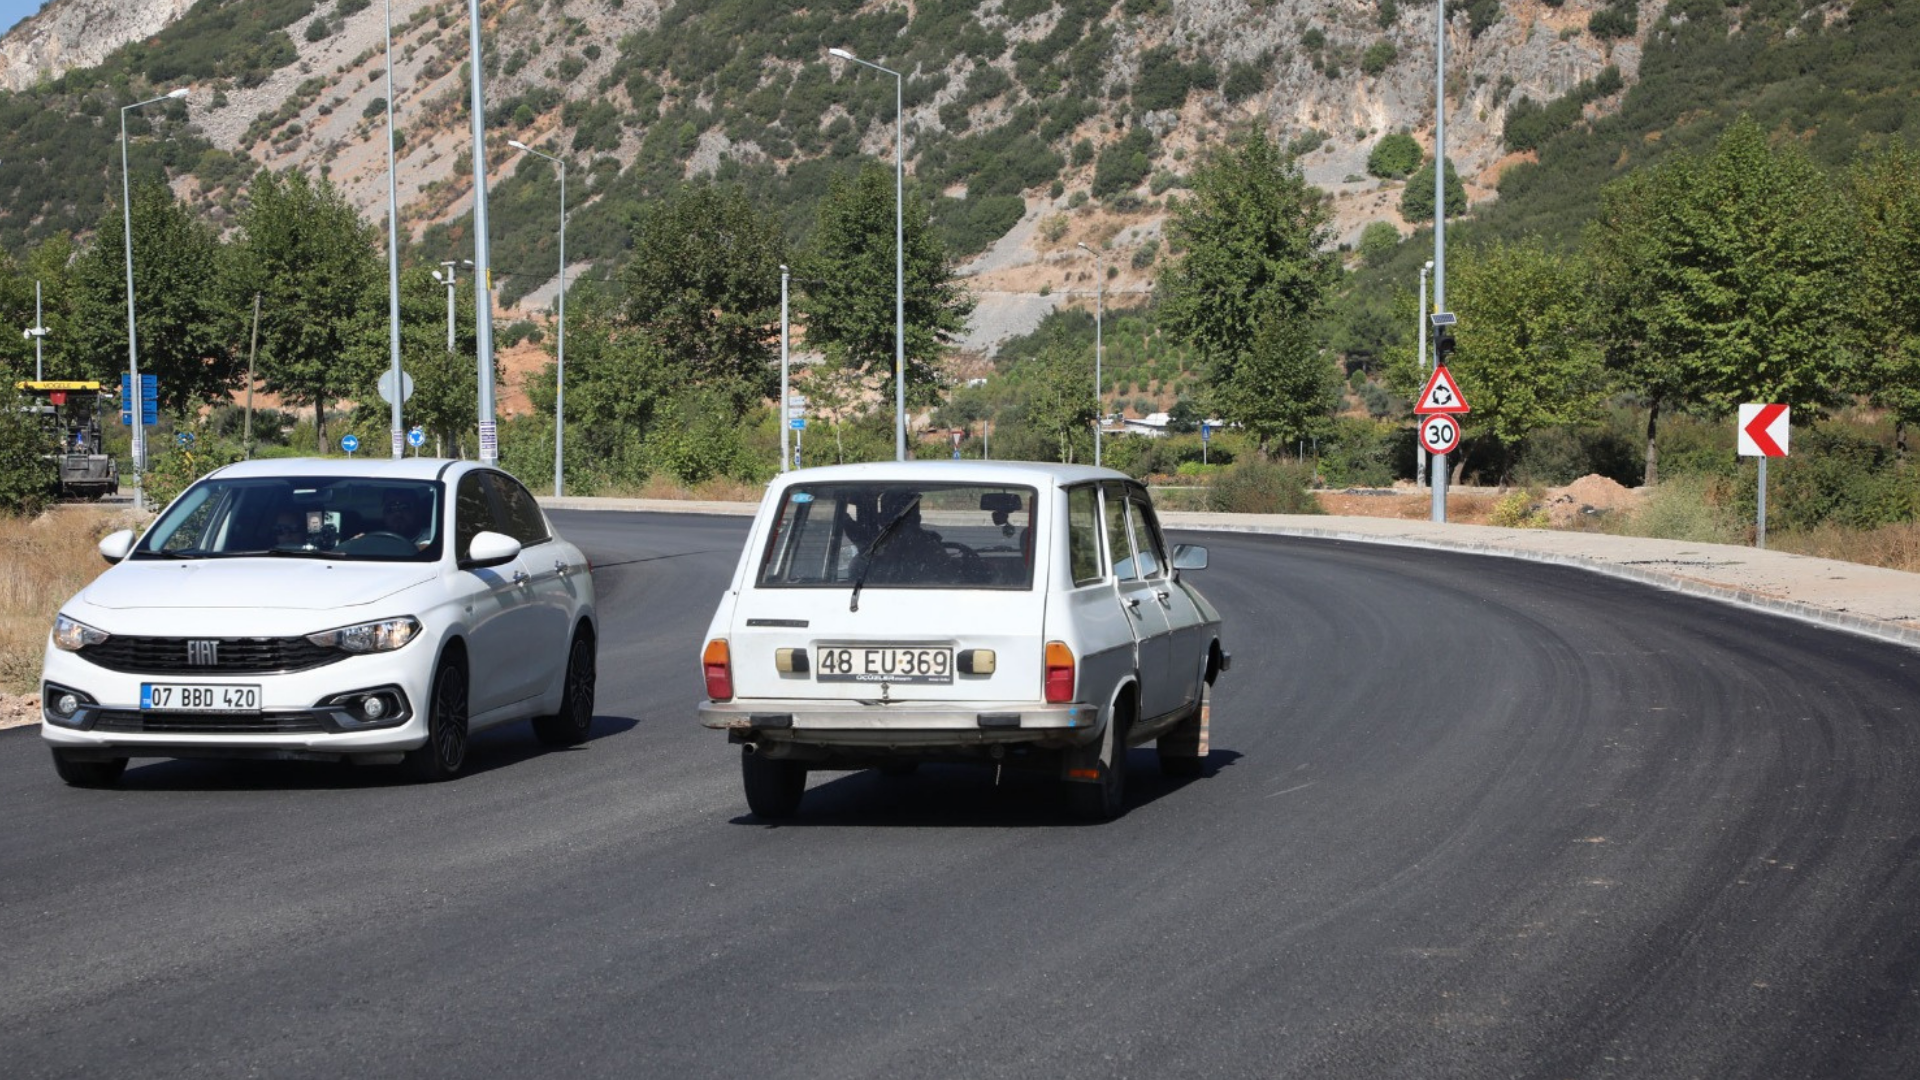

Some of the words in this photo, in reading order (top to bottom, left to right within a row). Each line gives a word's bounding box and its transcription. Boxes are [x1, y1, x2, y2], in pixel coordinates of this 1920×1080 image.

[1429, 424, 1453, 444] 30
[187, 639, 220, 666] FIAT
[821, 649, 853, 674] 48
[152, 688, 172, 707] 07
[182, 688, 214, 707] BBD
[223, 688, 256, 708] 420
